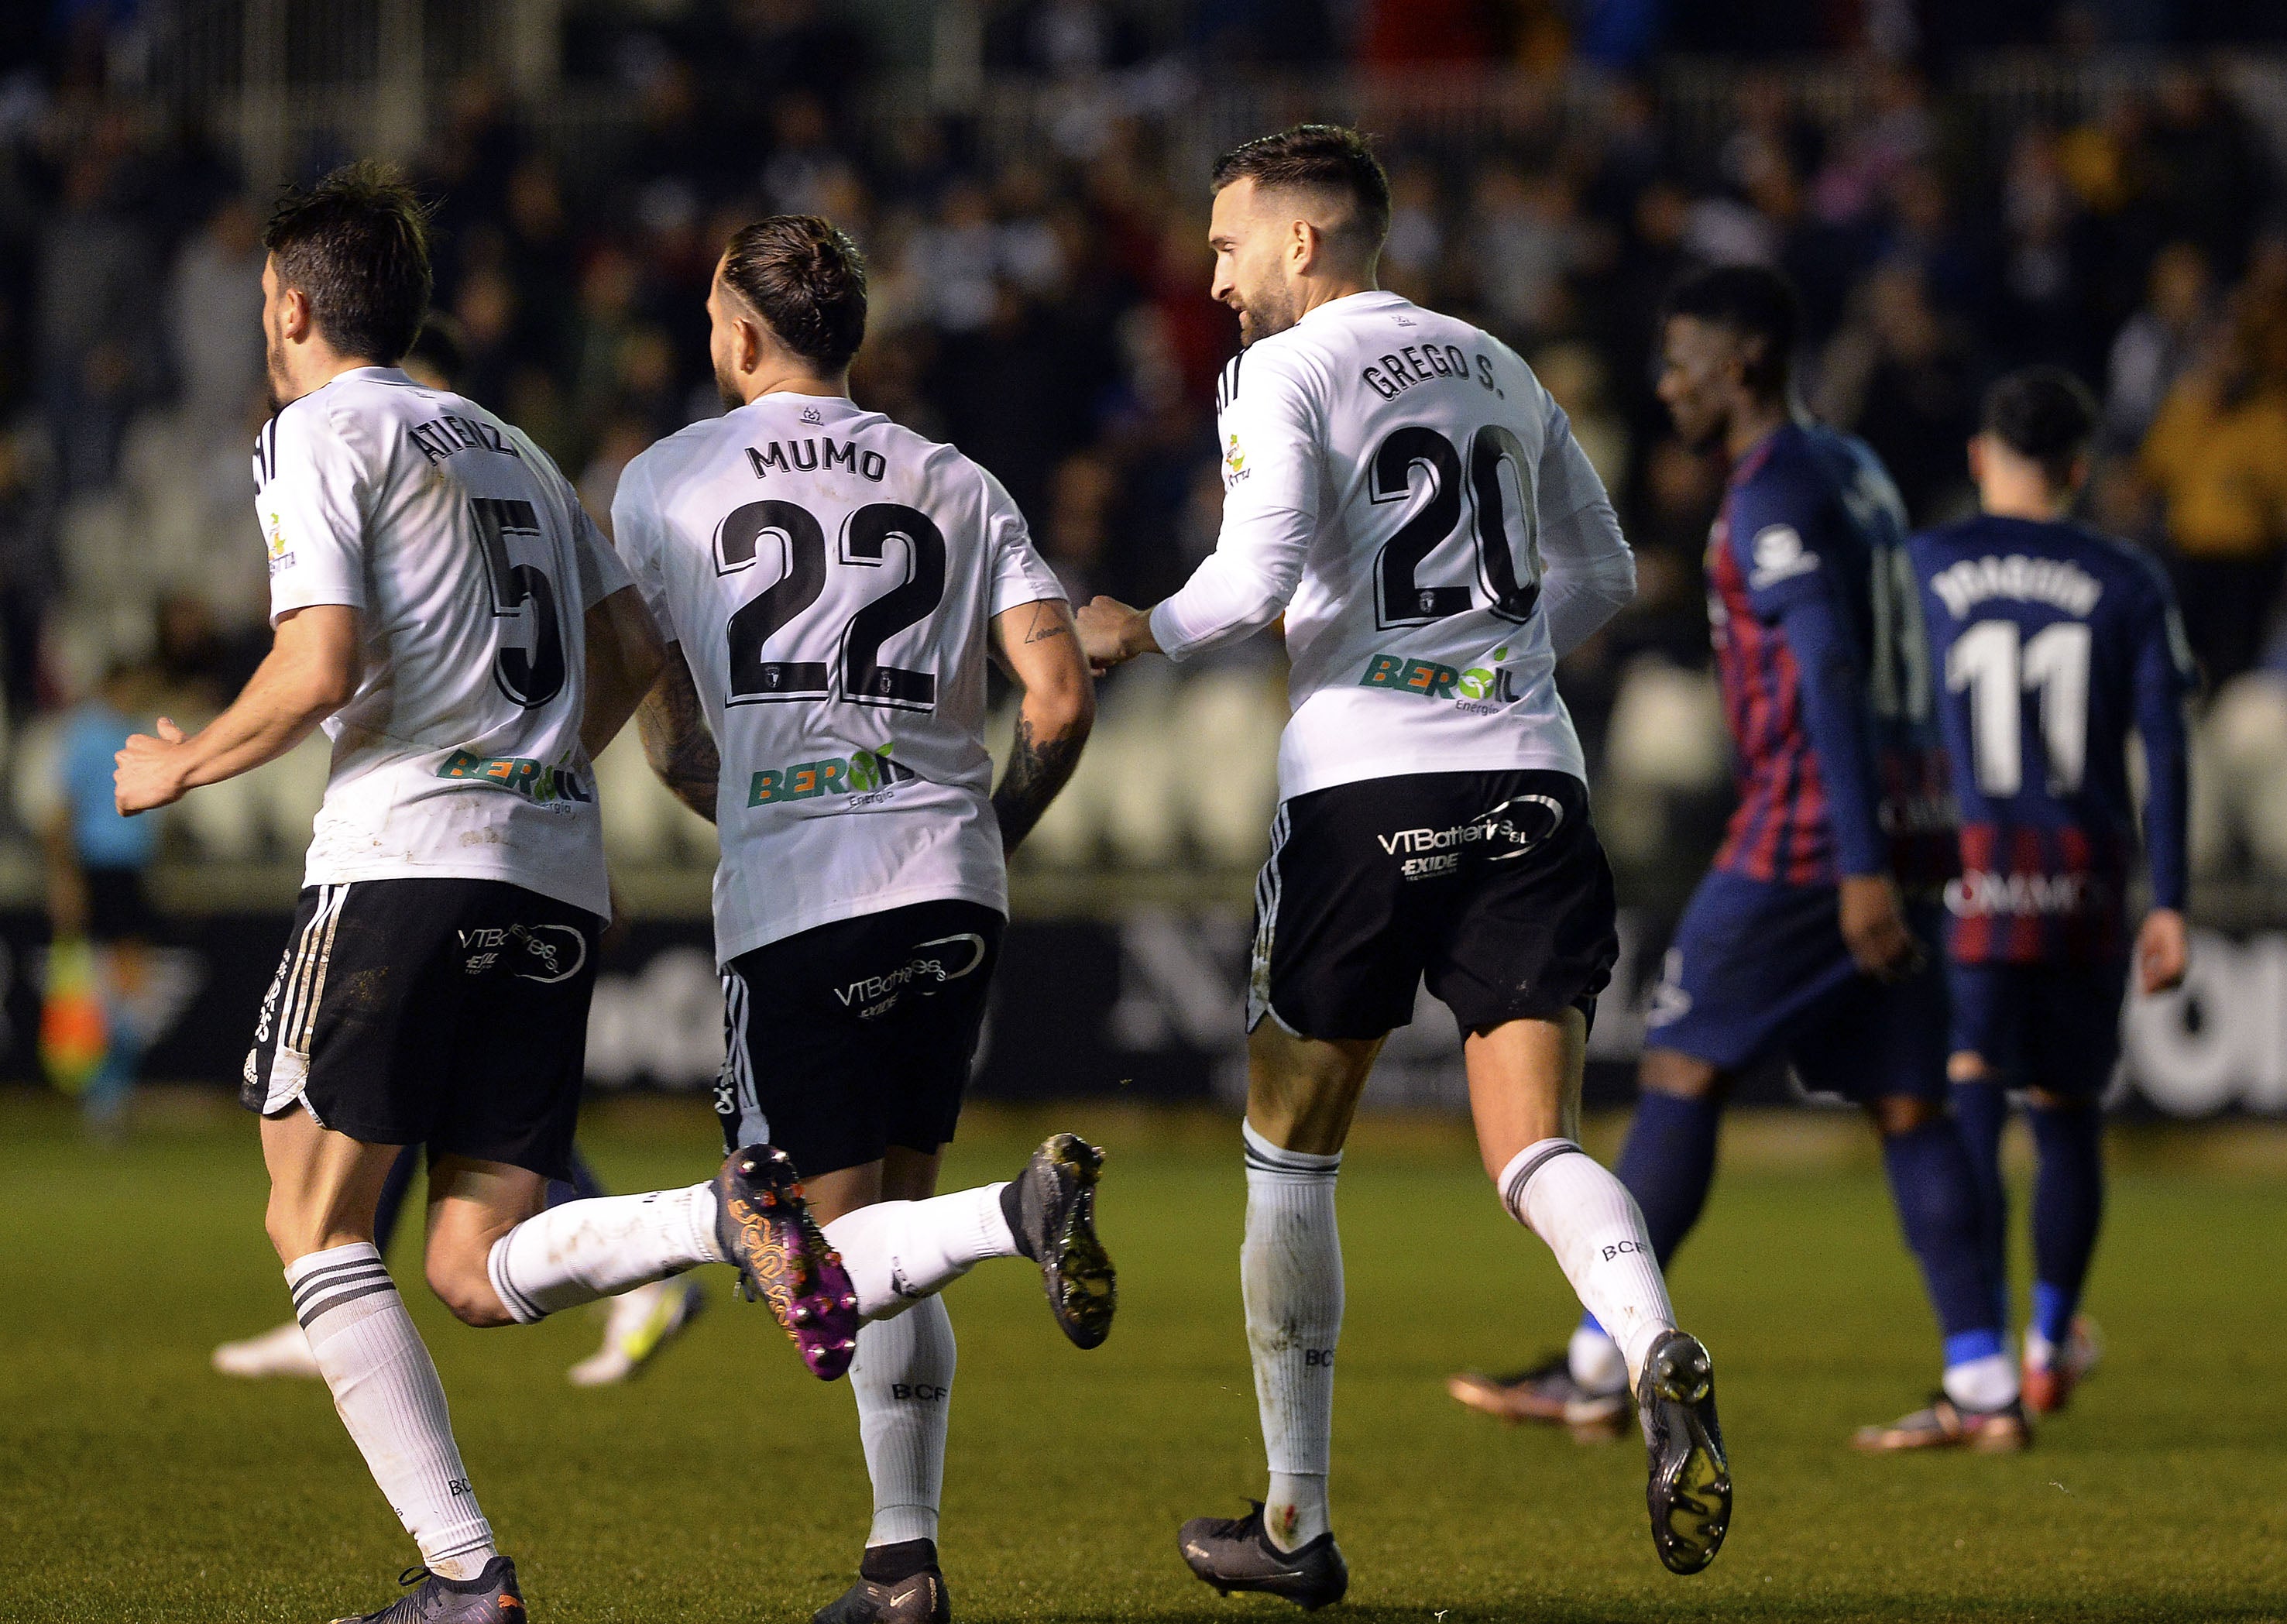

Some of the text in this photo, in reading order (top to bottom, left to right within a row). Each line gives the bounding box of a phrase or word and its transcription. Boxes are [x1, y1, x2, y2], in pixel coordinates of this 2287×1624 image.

[1362, 344, 1505, 402] GREGO S.
[744, 437, 887, 482] MUMO
[1368, 424, 1540, 631] 20
[468, 497, 568, 710] 5
[713, 499, 947, 714] 22
[1358, 651, 1522, 703] BEROIL
[1945, 618, 2093, 798] 11
[1401, 853, 1463, 876] EXIDE
